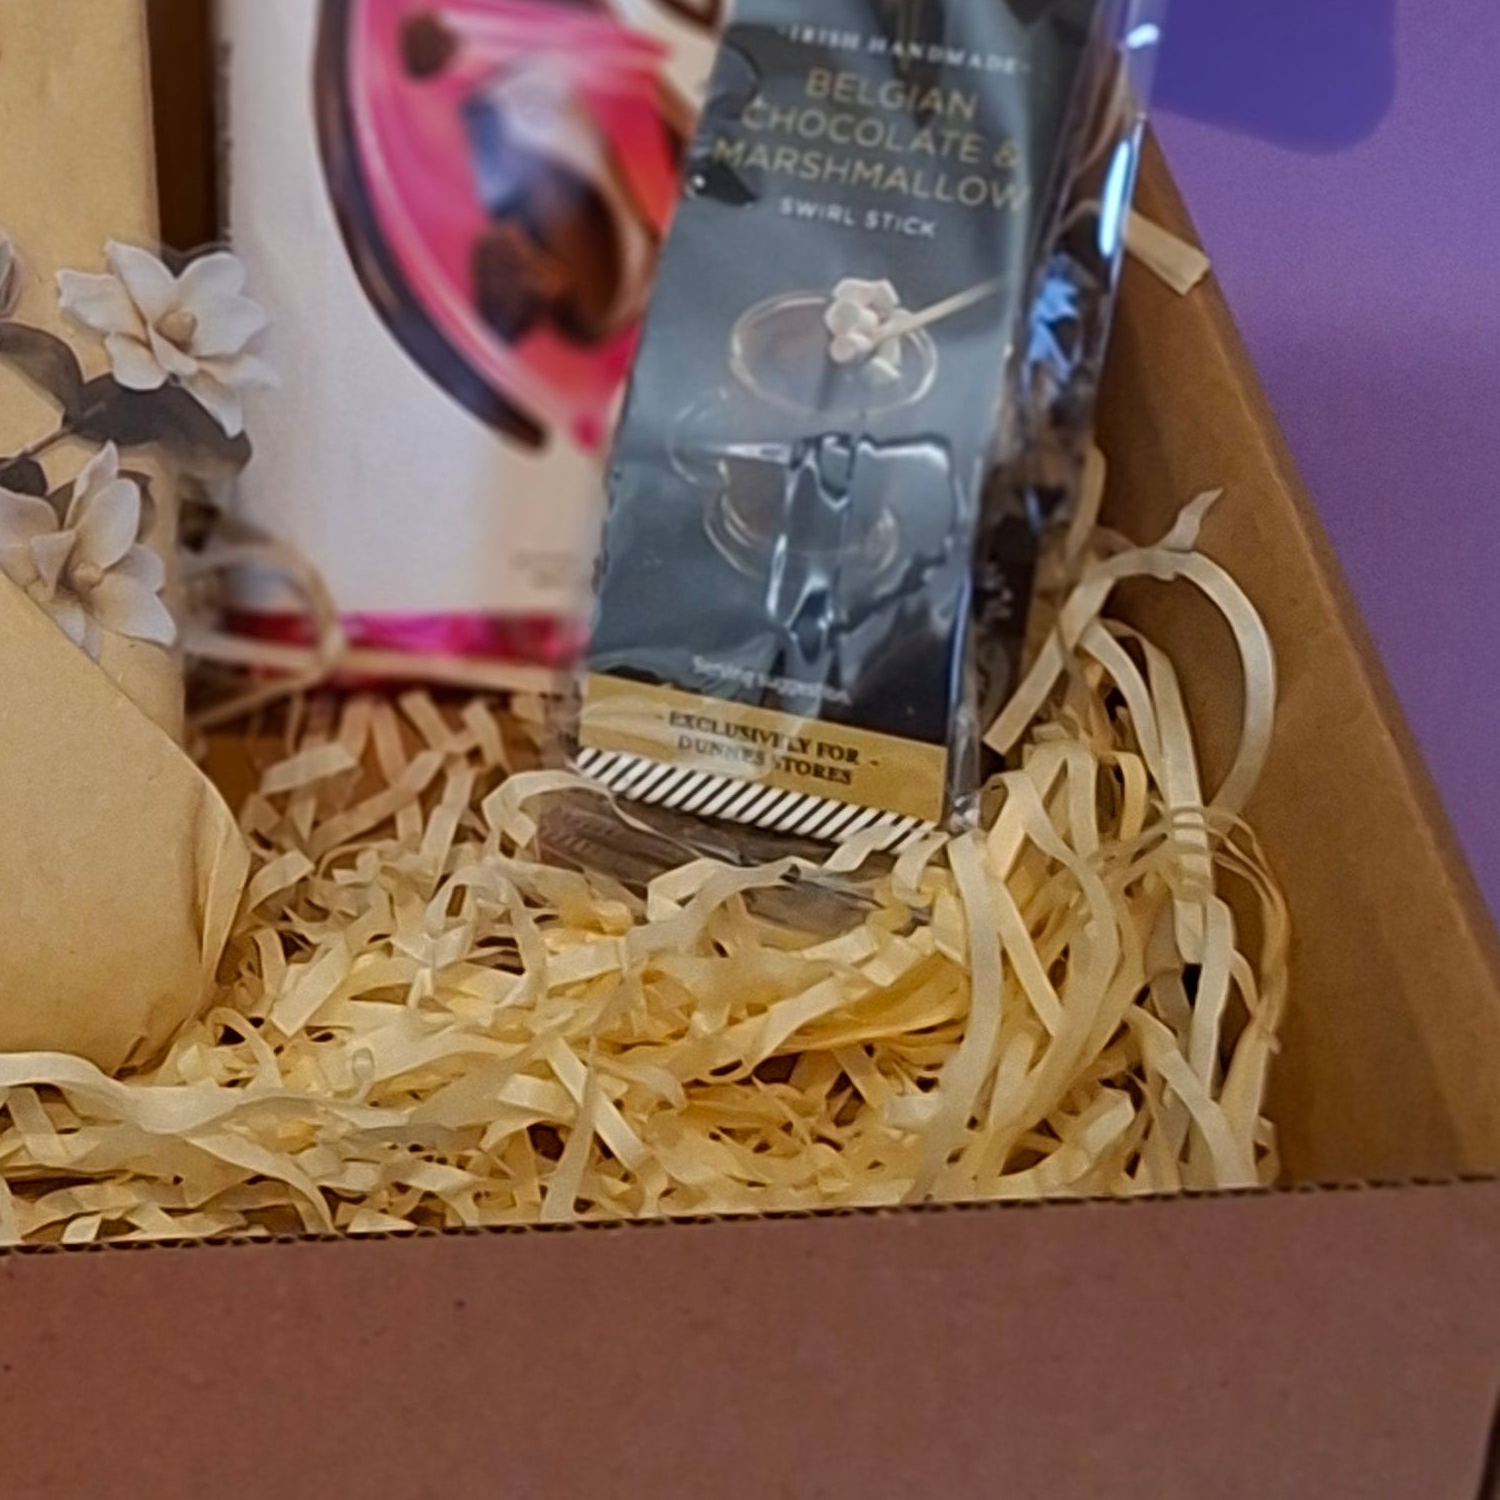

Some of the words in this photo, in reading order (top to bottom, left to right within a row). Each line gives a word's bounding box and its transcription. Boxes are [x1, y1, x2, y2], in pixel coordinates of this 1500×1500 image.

[804, 67, 979, 121] BELGIAN
[741, 101, 986, 164] CHOCOLATE
[712, 137, 1031, 212] MARSHMALLOW
[780, 197, 854, 228] SWIRL
[865, 208, 937, 238] STICK
[677, 734, 765, 766] DUNNES
[815, 741, 860, 766] FOR
